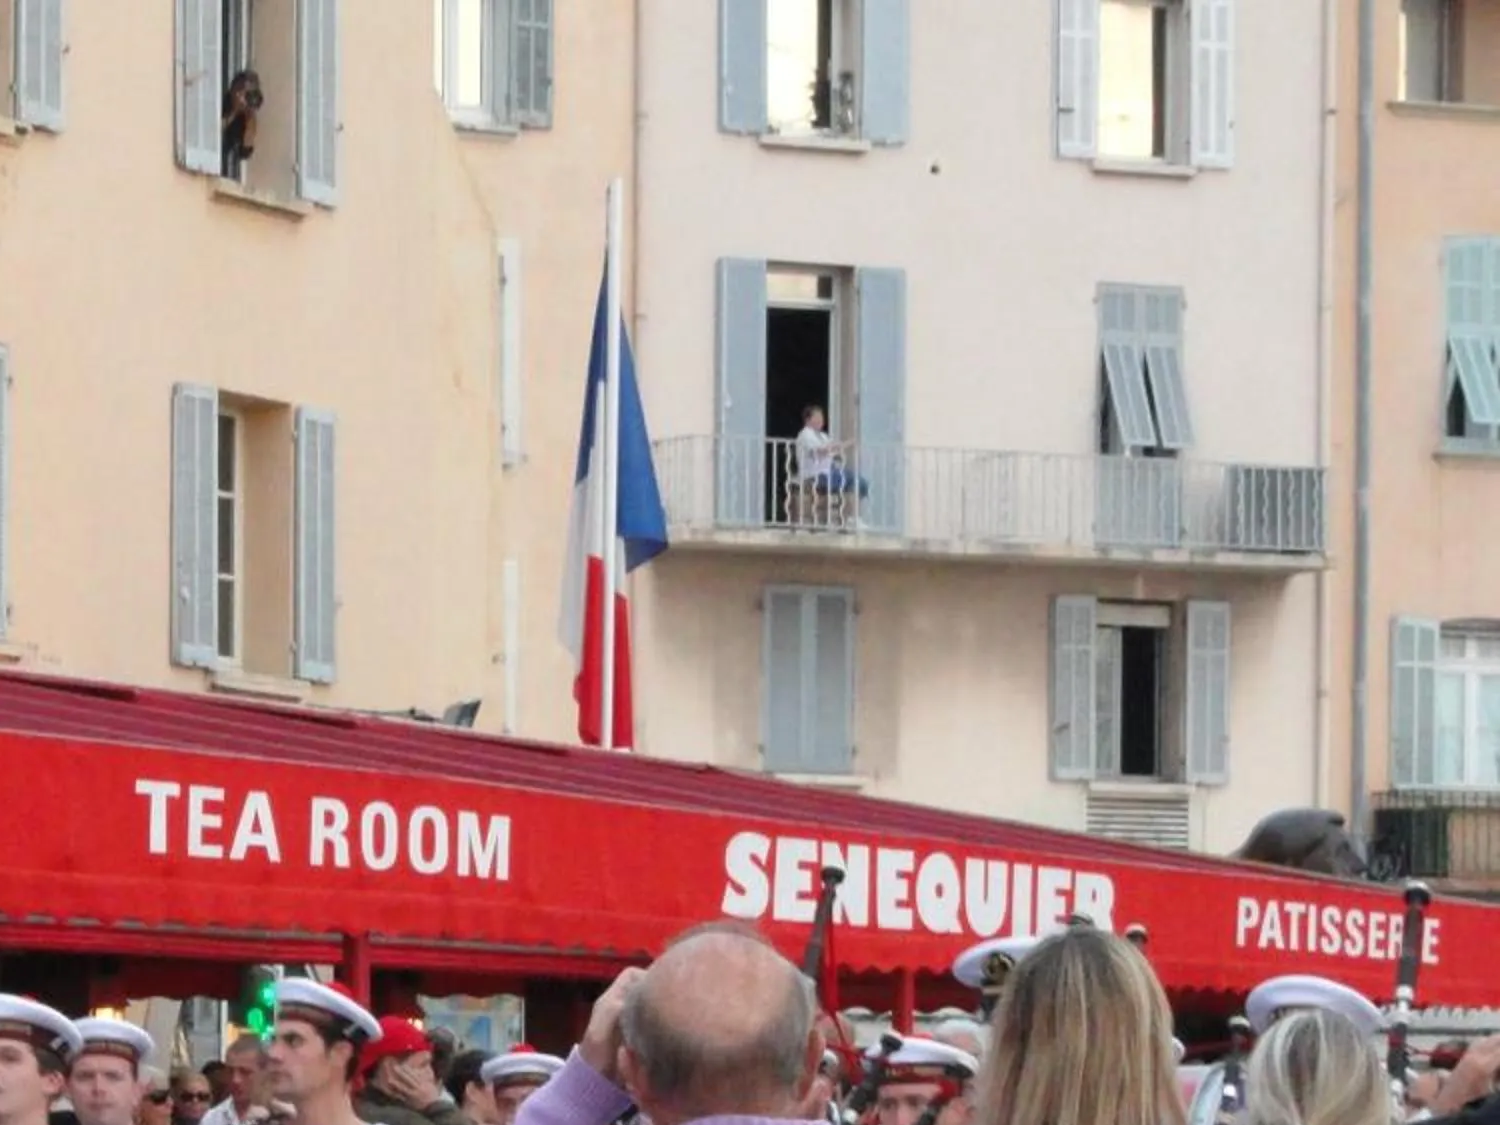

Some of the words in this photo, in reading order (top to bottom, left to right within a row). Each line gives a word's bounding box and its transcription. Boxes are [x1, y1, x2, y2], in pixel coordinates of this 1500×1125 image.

[135, 778, 281, 864] TEA
[309, 796, 511, 881] ROOM
[721, 831, 1116, 938] SENEQUIER
[1235, 896, 1441, 964] PATISSERE
